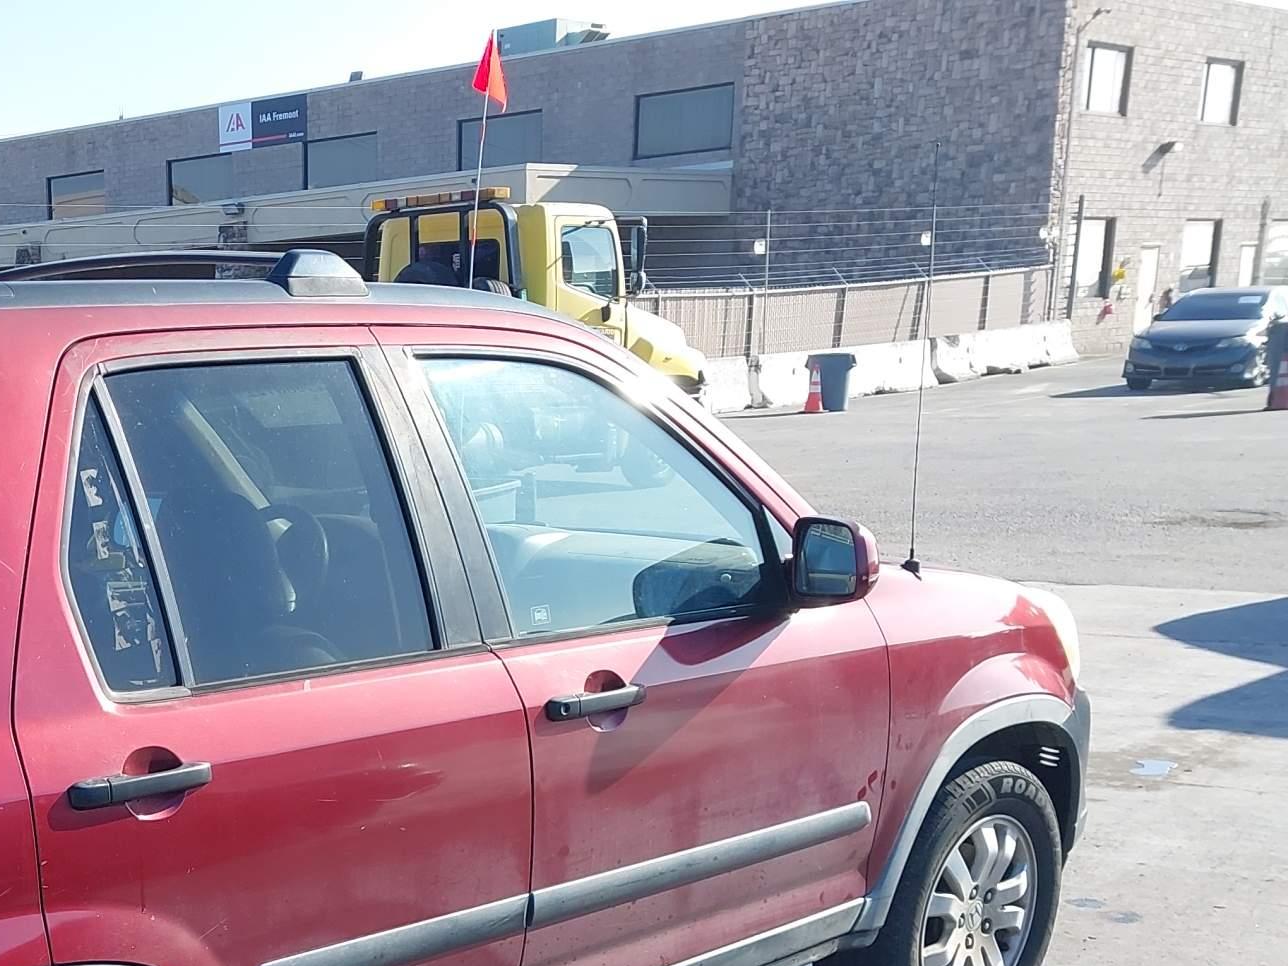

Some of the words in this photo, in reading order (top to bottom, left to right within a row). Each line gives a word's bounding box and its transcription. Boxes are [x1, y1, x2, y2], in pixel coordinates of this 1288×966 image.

[259, 112, 272, 123] IAA
[272, 109, 299, 121] Fremont
[1000, 777, 1048, 808] ROAD
